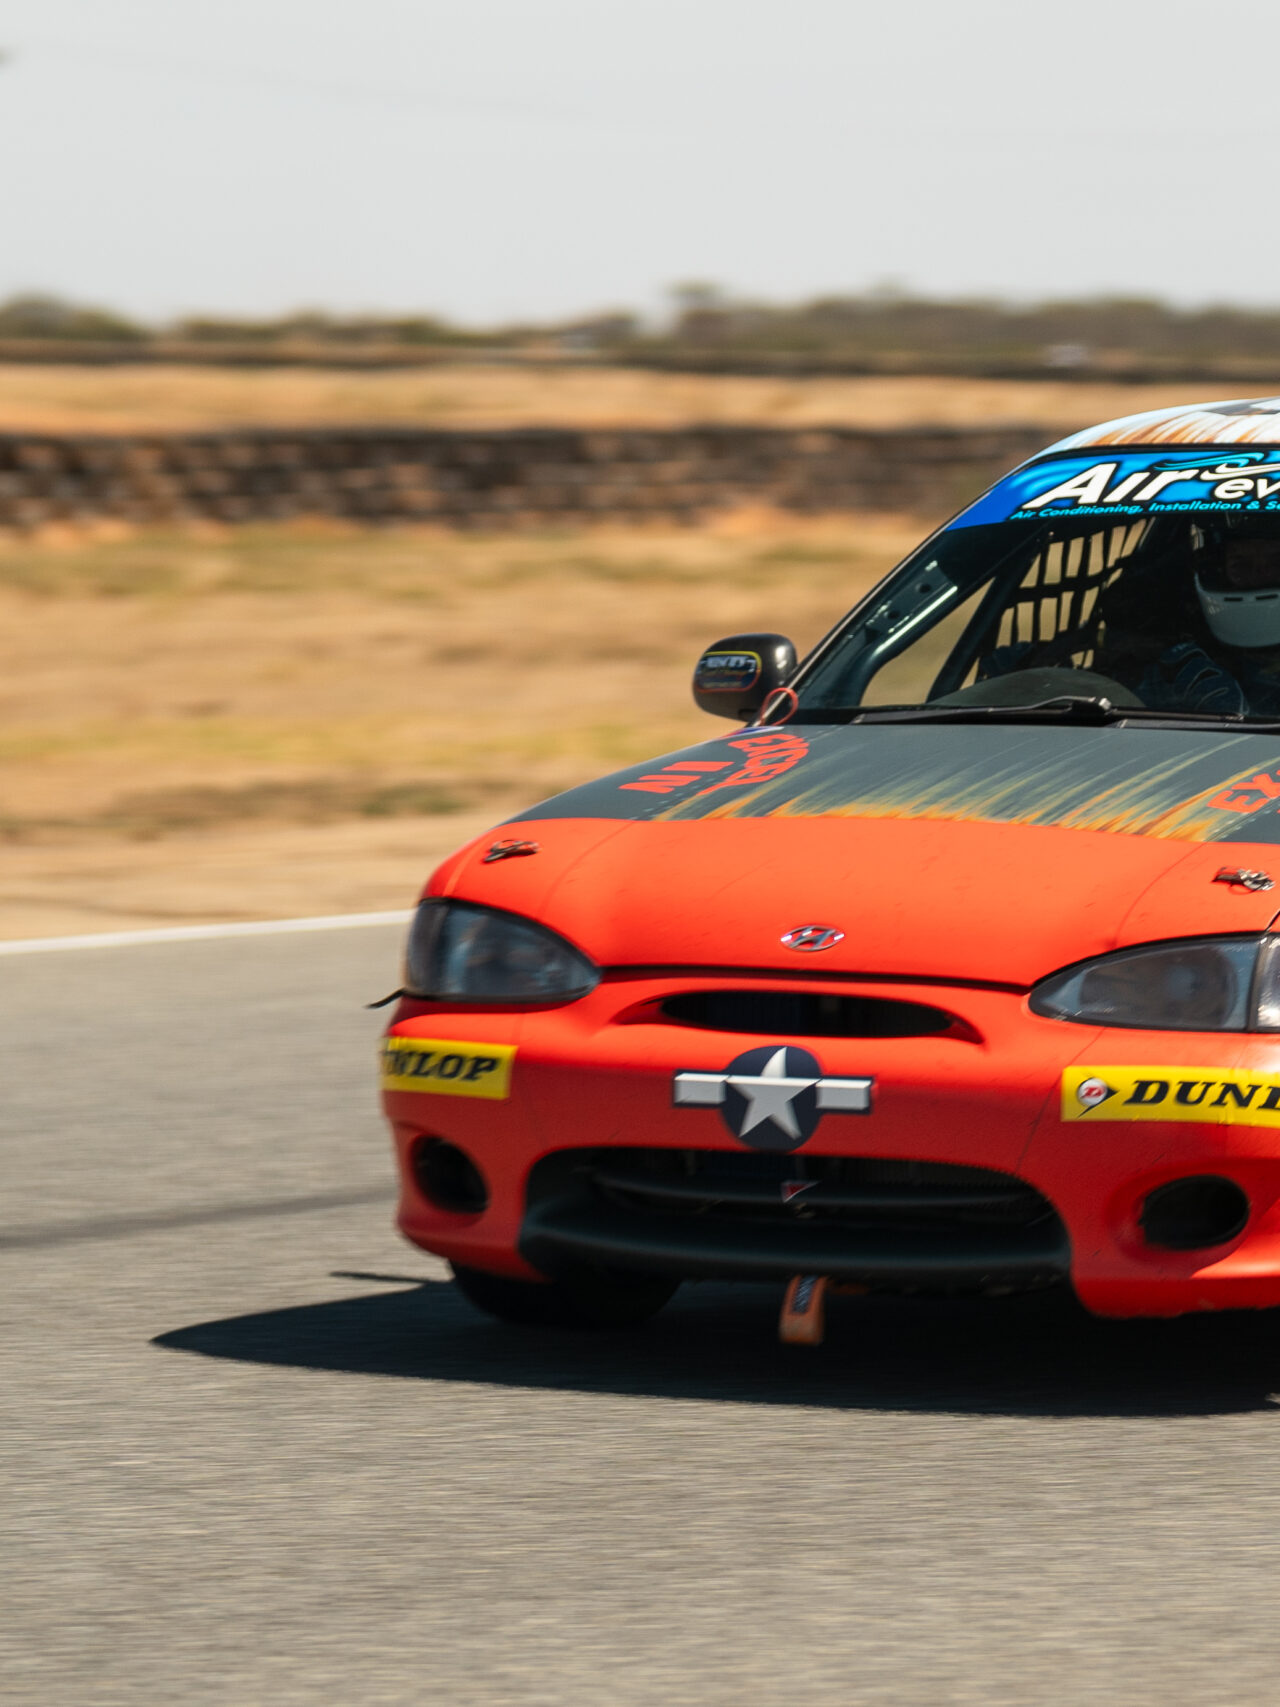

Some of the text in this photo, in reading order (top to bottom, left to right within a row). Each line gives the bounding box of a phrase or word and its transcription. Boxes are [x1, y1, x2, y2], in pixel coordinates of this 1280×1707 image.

[1022, 462, 1199, 509] Air
[1010, 510, 1036, 521] Air
[1039, 503, 1144, 517] Conditioning,
[1150, 501, 1242, 512] Installation
[1247, 501, 1260, 511] &
